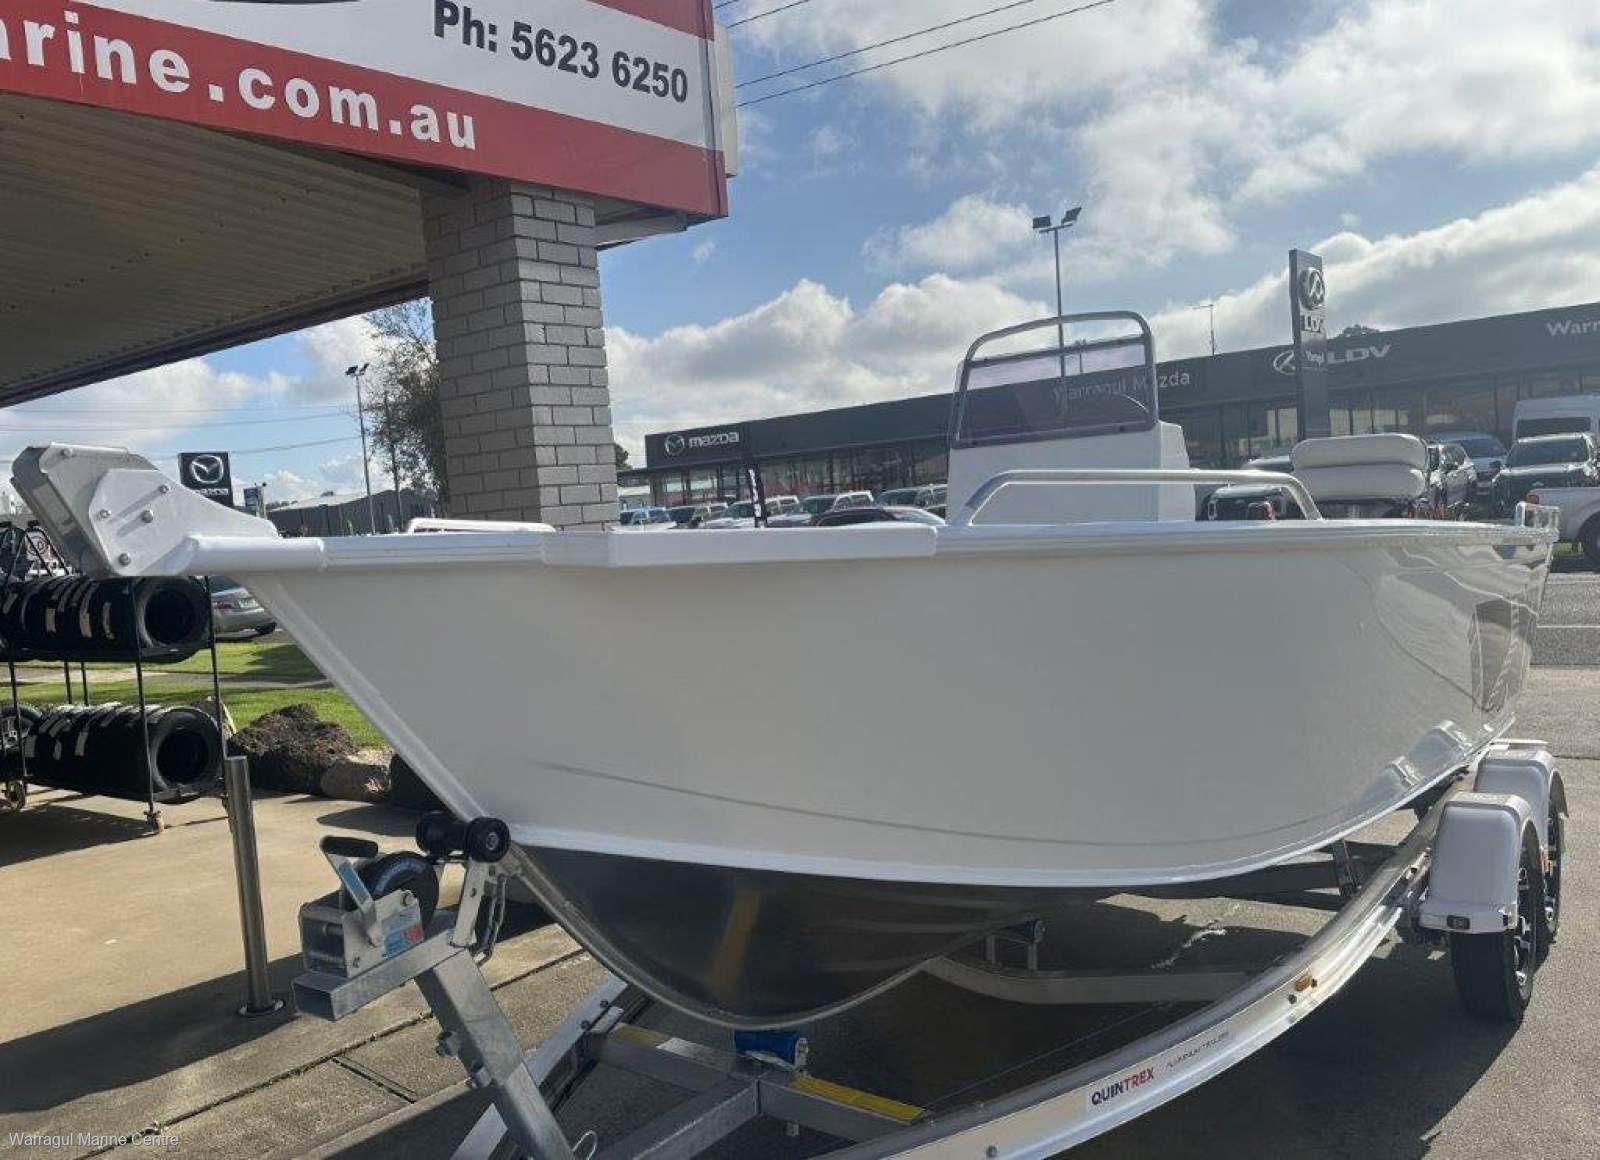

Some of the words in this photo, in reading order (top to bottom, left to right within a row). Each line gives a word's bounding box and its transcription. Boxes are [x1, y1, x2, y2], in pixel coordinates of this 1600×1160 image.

[434, 0, 497, 54] Ph:
[511, 22, 599, 79] 5623
[612, 50, 688, 103] 6250
[1326, 344, 1392, 365] LDV
[1132, 371, 1191, 393] Mzda
[688, 431, 740, 448] mazda
[1091, 1067, 1155, 1106] QUINTREX
